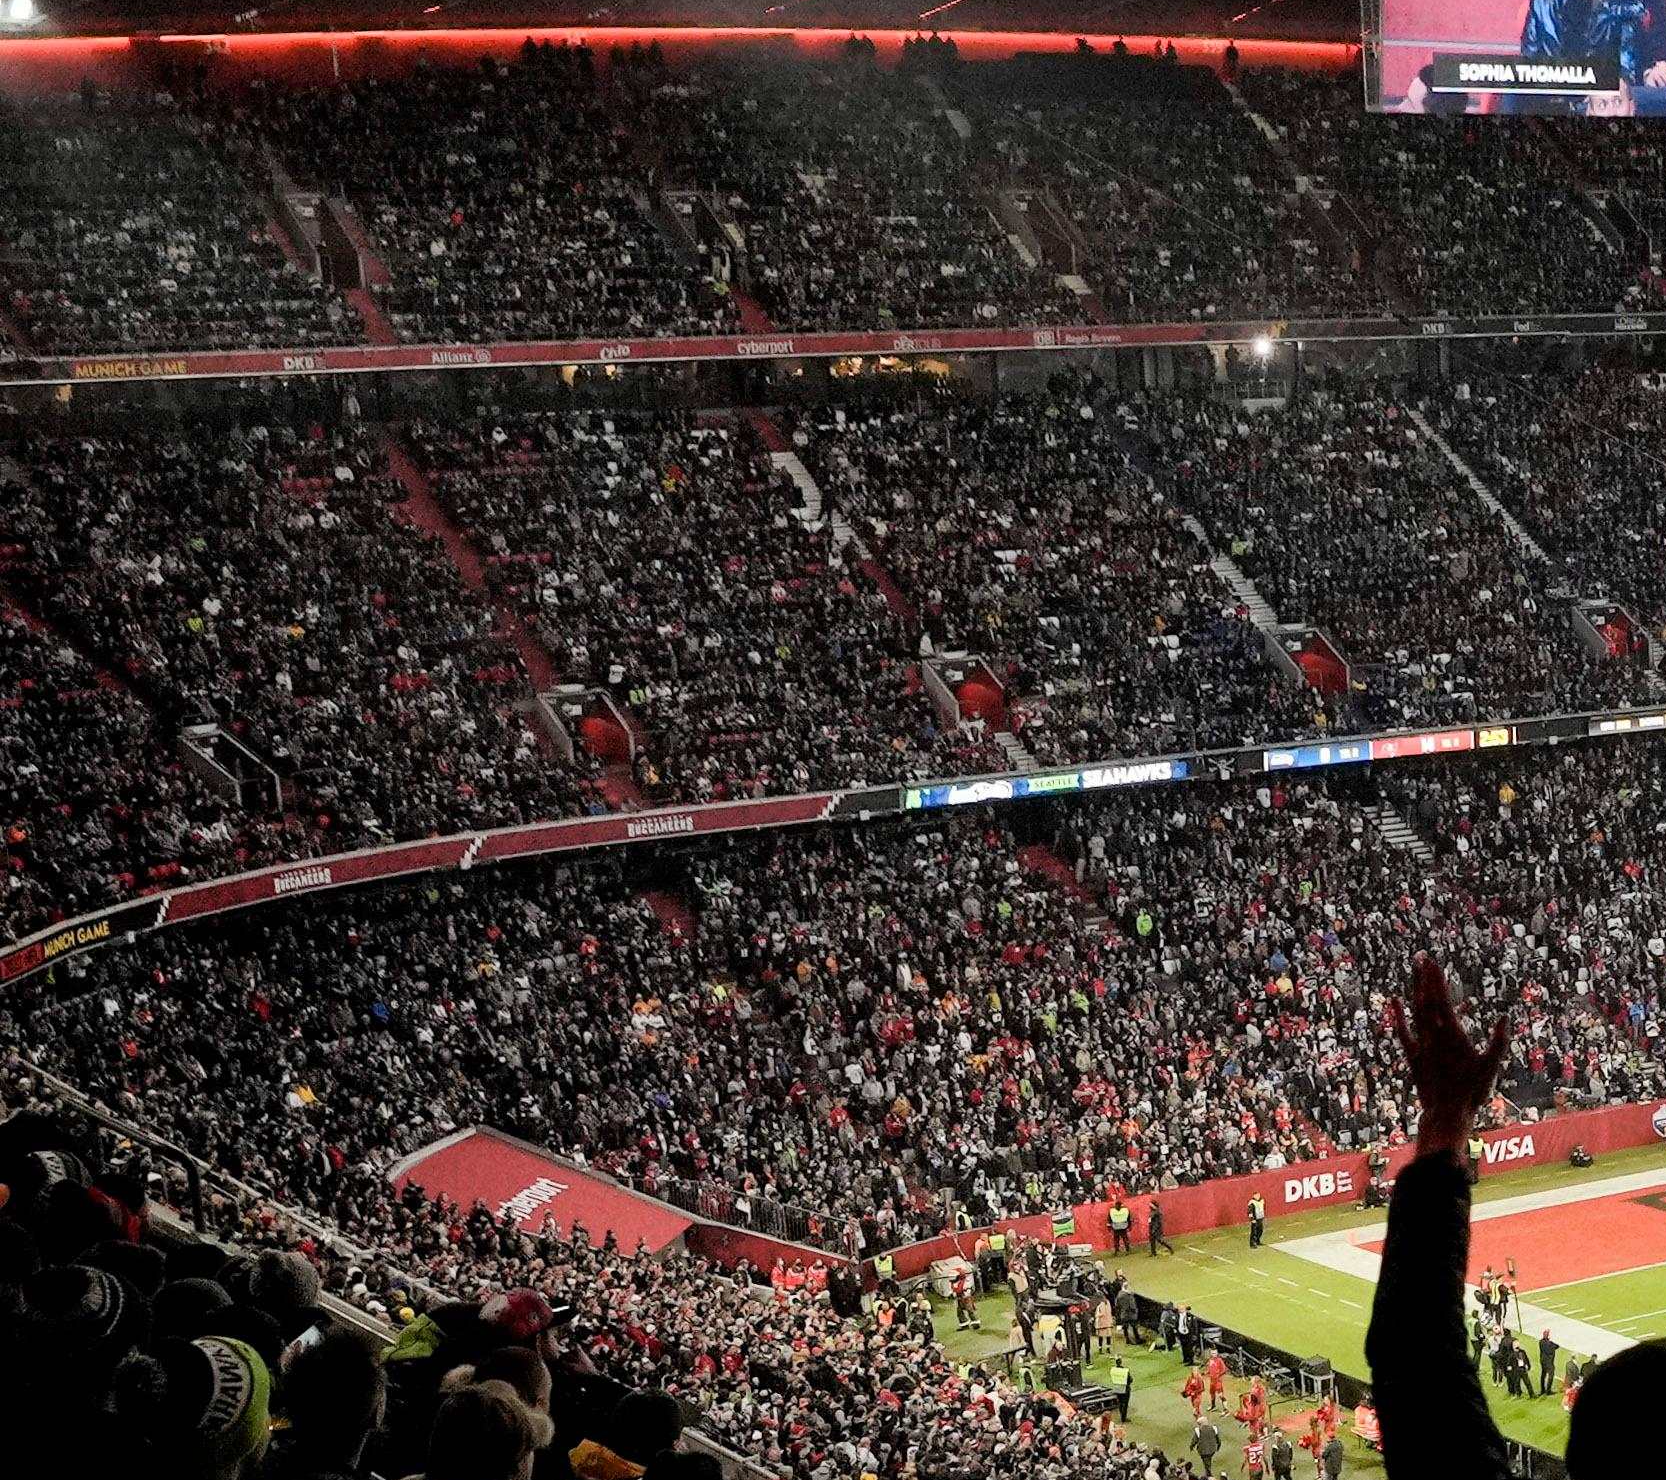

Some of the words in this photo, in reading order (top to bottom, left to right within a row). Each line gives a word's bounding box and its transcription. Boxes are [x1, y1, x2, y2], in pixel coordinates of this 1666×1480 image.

[1459, 64, 1514, 82] SOPHIA
[1516, 65, 1596, 84] THOMALLA
[432, 352, 473, 364] Allianz
[737, 339, 794, 355] cyberport
[75, 362, 137, 378] MUNICH
[139, 360, 187, 375] GAME
[1033, 776, 1074, 791] SEATTLE
[1082, 763, 1172, 789] SEAHAWKS
[627, 816, 694, 838] BUCCANEERS
[274, 868, 332, 894] BUCCANEERS
[43, 930, 76, 959] MUNICH
[76, 920, 111, 944] GAME
[1484, 1134, 1535, 1165] VISA
[1285, 1172, 1336, 1203] DKB
